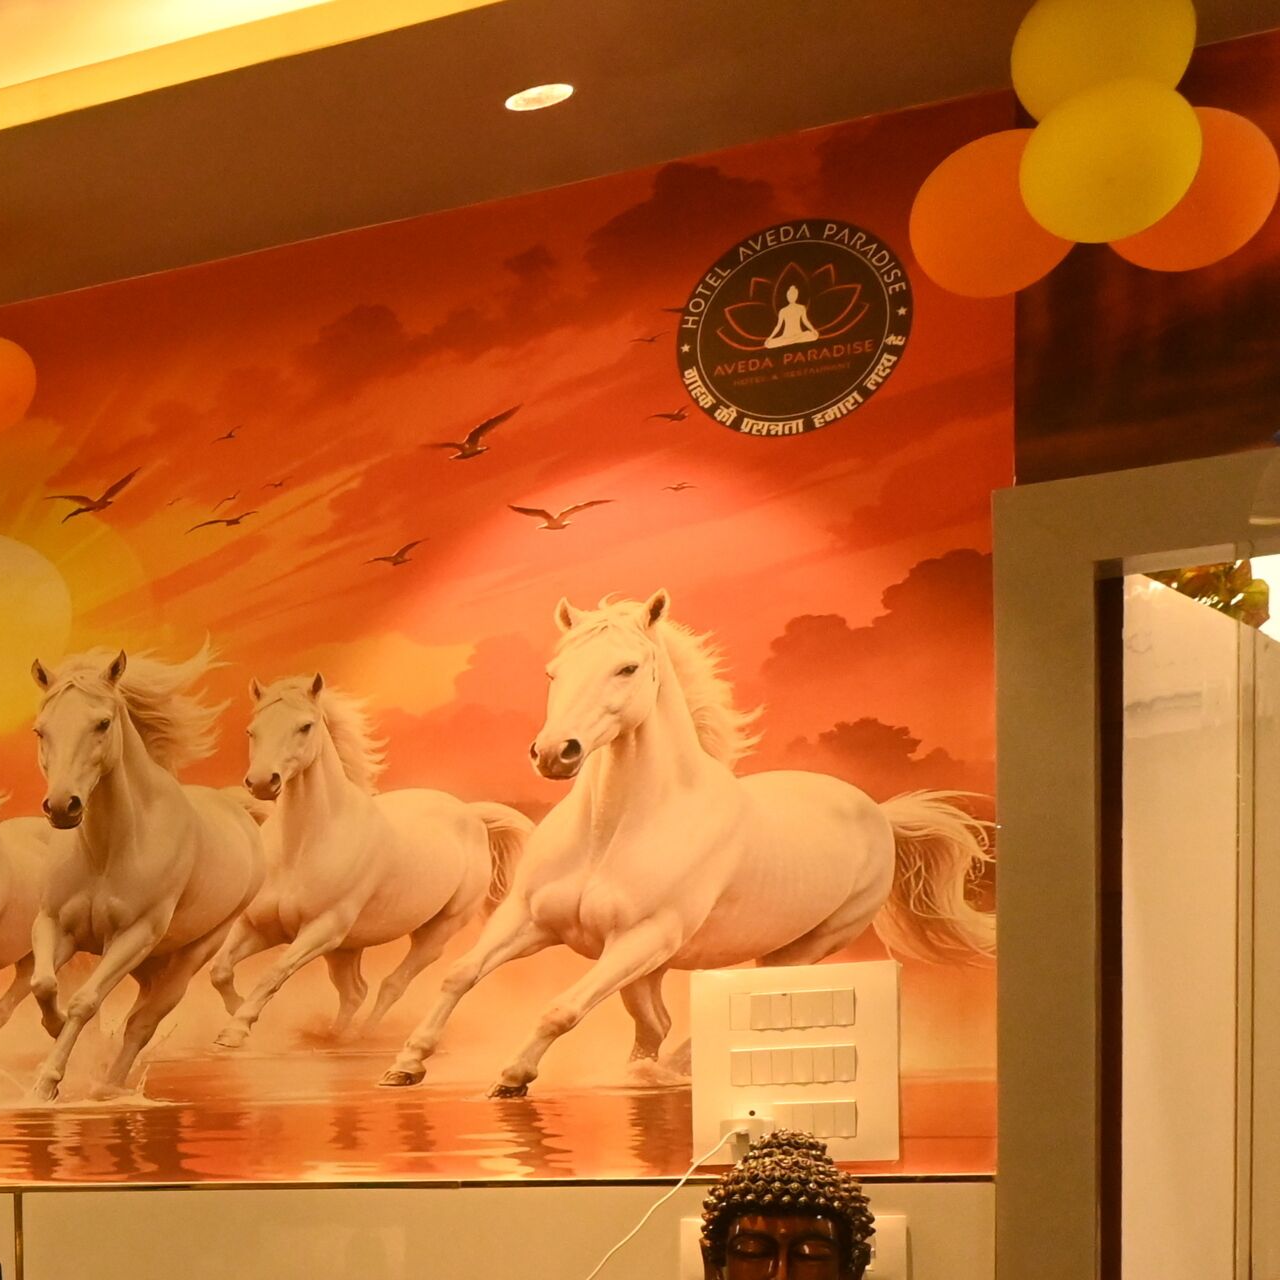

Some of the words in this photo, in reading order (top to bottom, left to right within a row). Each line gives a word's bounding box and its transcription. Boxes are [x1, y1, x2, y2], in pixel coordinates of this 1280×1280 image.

[682, 267, 731, 328] HOTEL
[739, 223, 811, 262] AVEDA
[823, 223, 907, 295] PARADISE
[683, 366, 717, 409] ग्राहक
[713, 405, 738, 427] की
[740, 417, 804, 436] प्रसन्नता
[811, 390, 864, 428] हमारा
[862, 352, 898, 391] लक्ष्य
[884, 333, 906, 346] है
[714, 357, 773, 377] AVEDA
[783, 339, 875, 365] PARADISE
